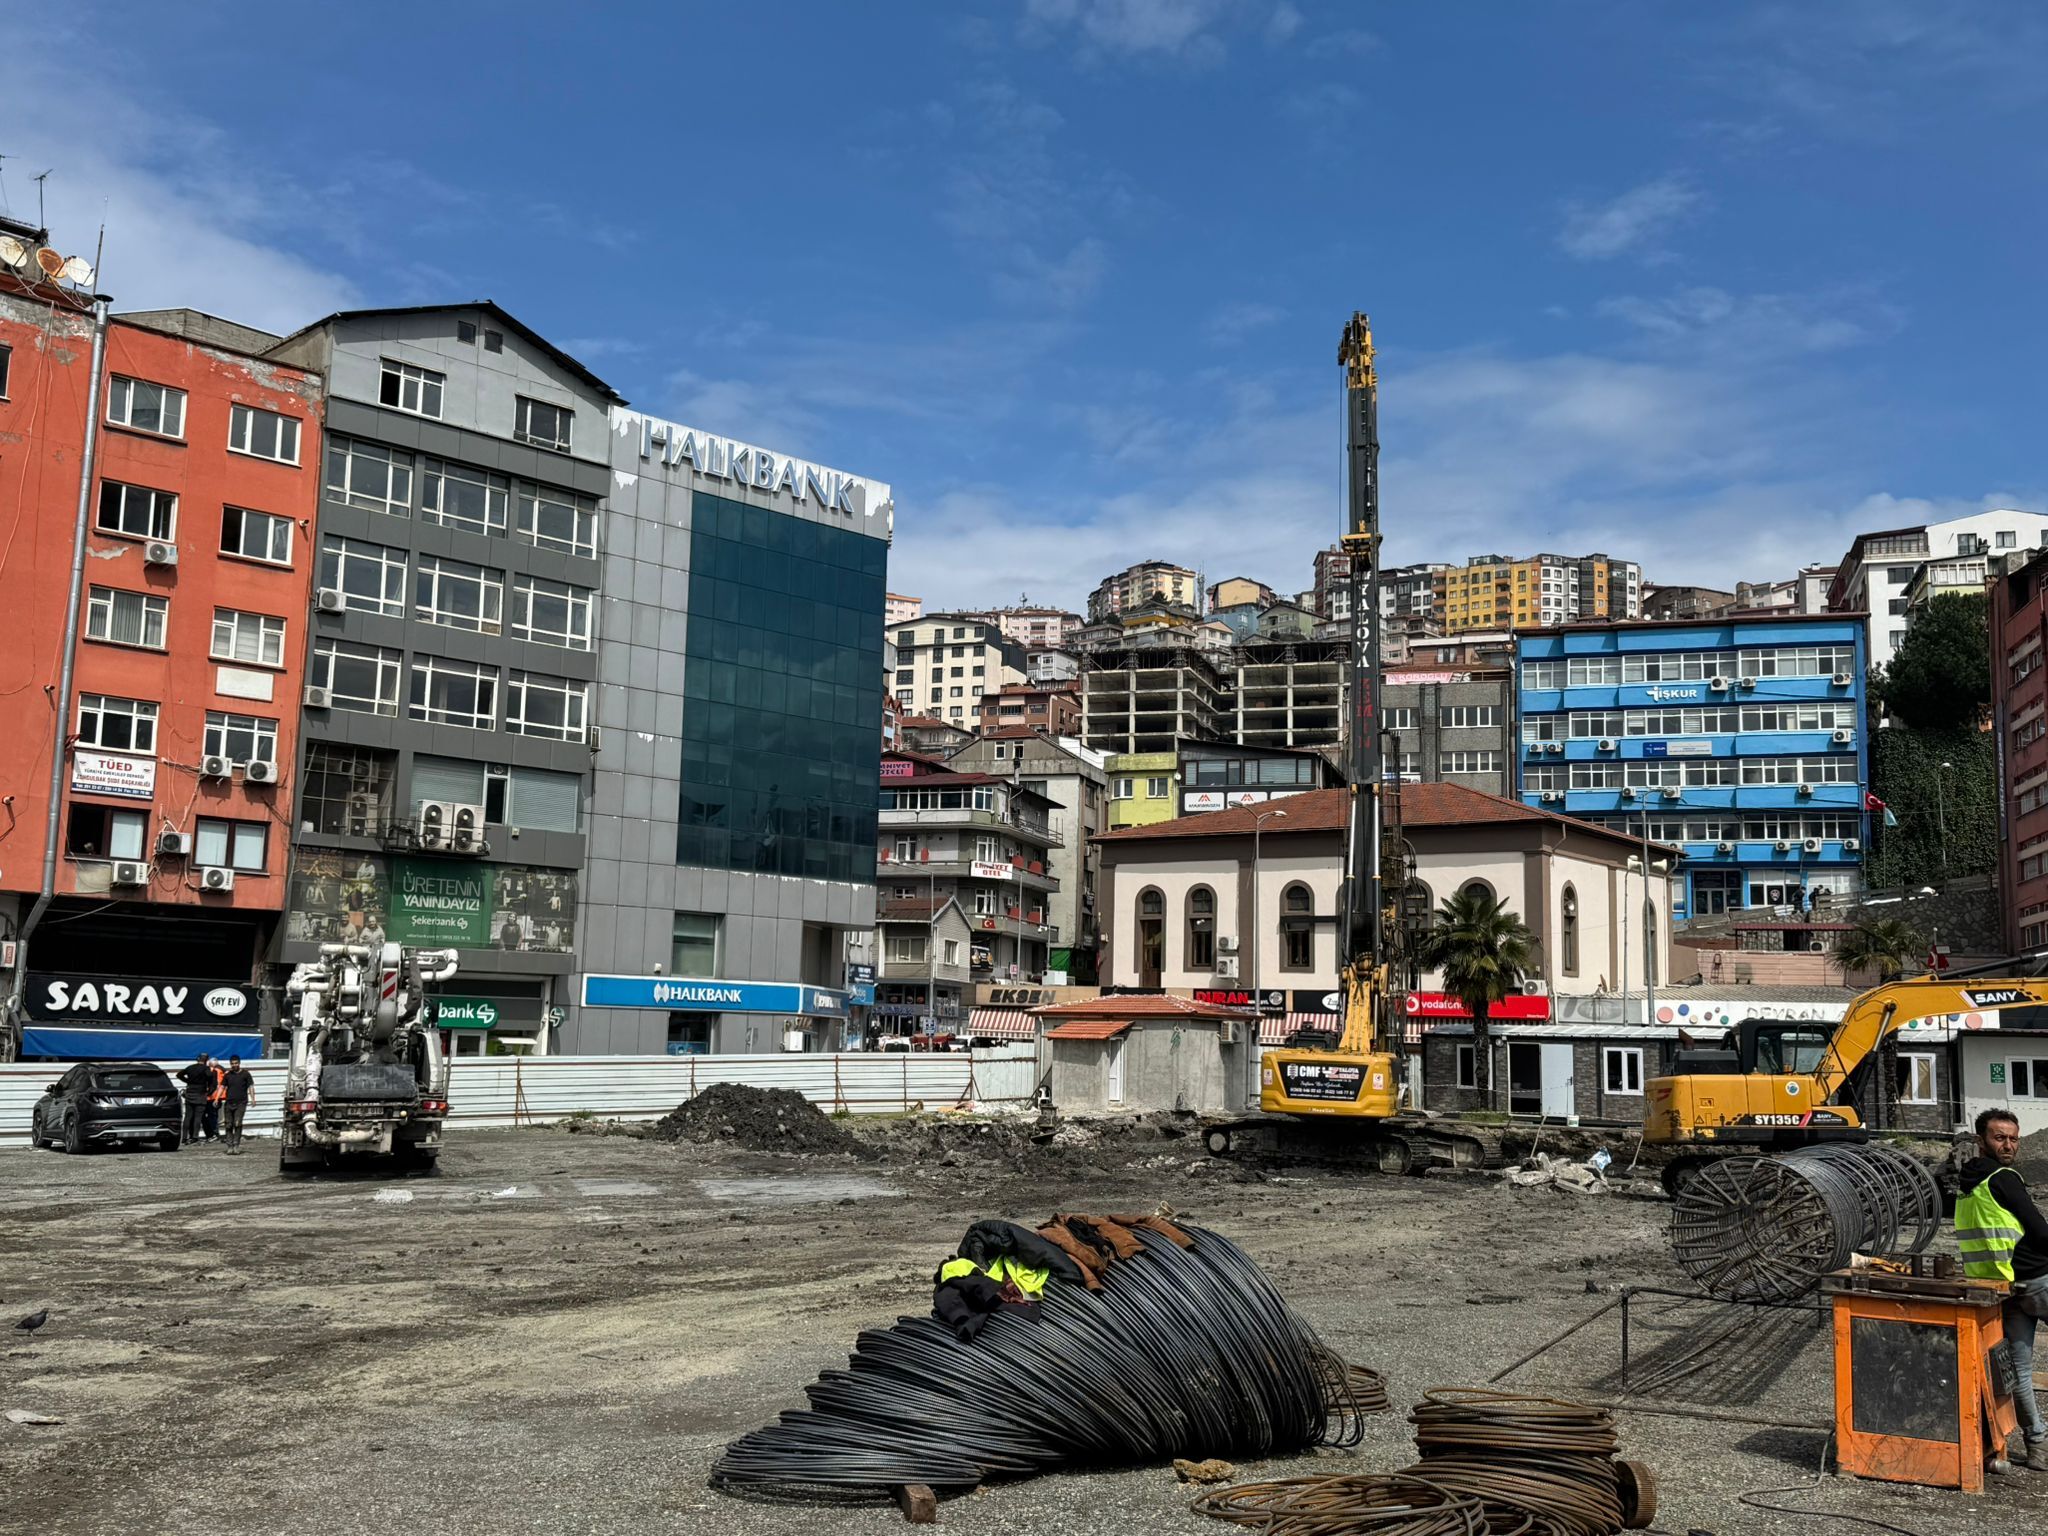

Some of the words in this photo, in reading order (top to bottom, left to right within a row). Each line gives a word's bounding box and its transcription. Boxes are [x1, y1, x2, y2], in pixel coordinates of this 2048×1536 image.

[640, 418, 854, 514] HALKBANK
[1356, 583, 1370, 668] YALOVA
[1659, 688, 1697, 700] İŞKUR
[98, 758, 133, 772] TÜED
[402, 871, 481, 898] ÜRETENİN
[402, 894, 480, 911] YANINDAYIZ!
[411, 914, 456, 927] Şekerbank
[45, 981, 188, 1015] SARAY
[211, 996, 226, 1008] ÇAY
[227, 995, 241, 1007] EVİ
[670, 986, 742, 1003] HALKBANK
[989, 988, 1056, 1004] EKSEN
[1195, 990, 1249, 1004] DURAN
[1975, 990, 2017, 1003] SANY
[1299, 1065, 1321, 1078] CMF
[1755, 1114, 1800, 1125] SY135C
